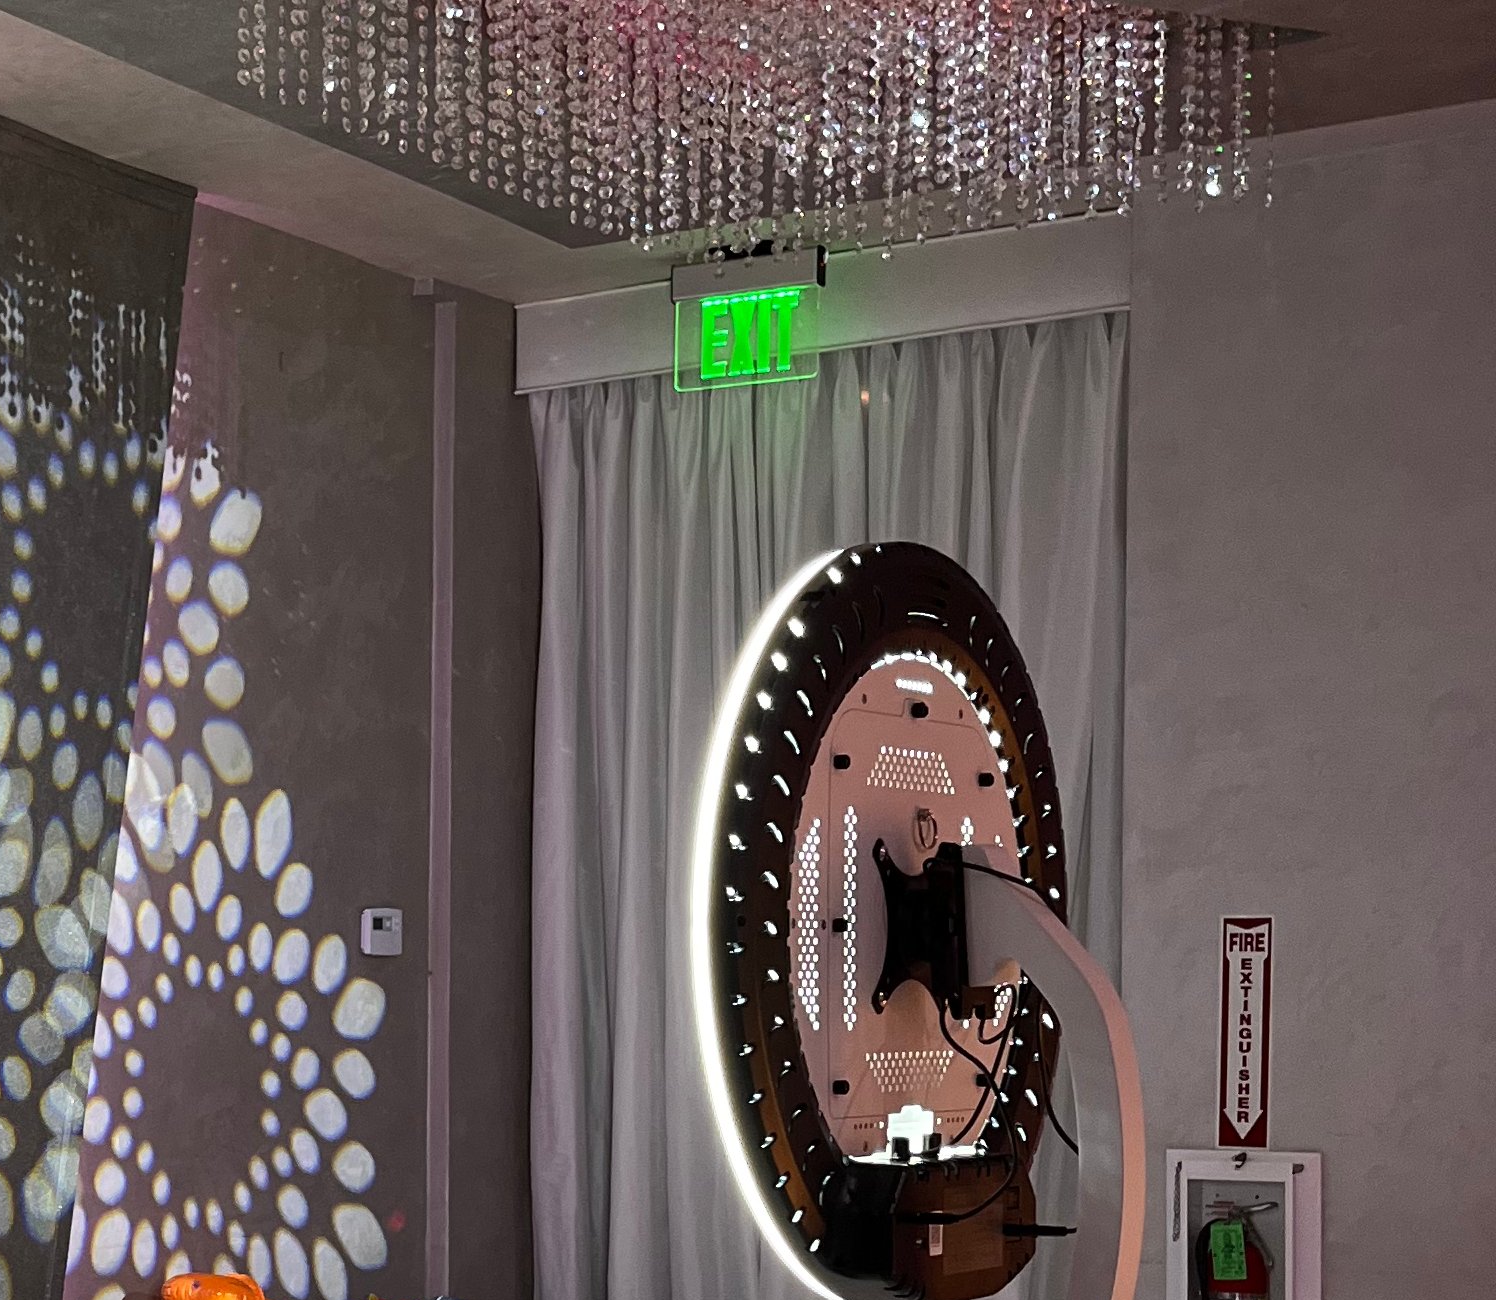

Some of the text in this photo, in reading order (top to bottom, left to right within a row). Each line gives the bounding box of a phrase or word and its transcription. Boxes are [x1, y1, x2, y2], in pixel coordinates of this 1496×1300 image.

[701, 290, 800, 380] EXIT
[1229, 932, 1266, 952] FIRE
[1237, 958, 1253, 1123] EXTINGUISHER
